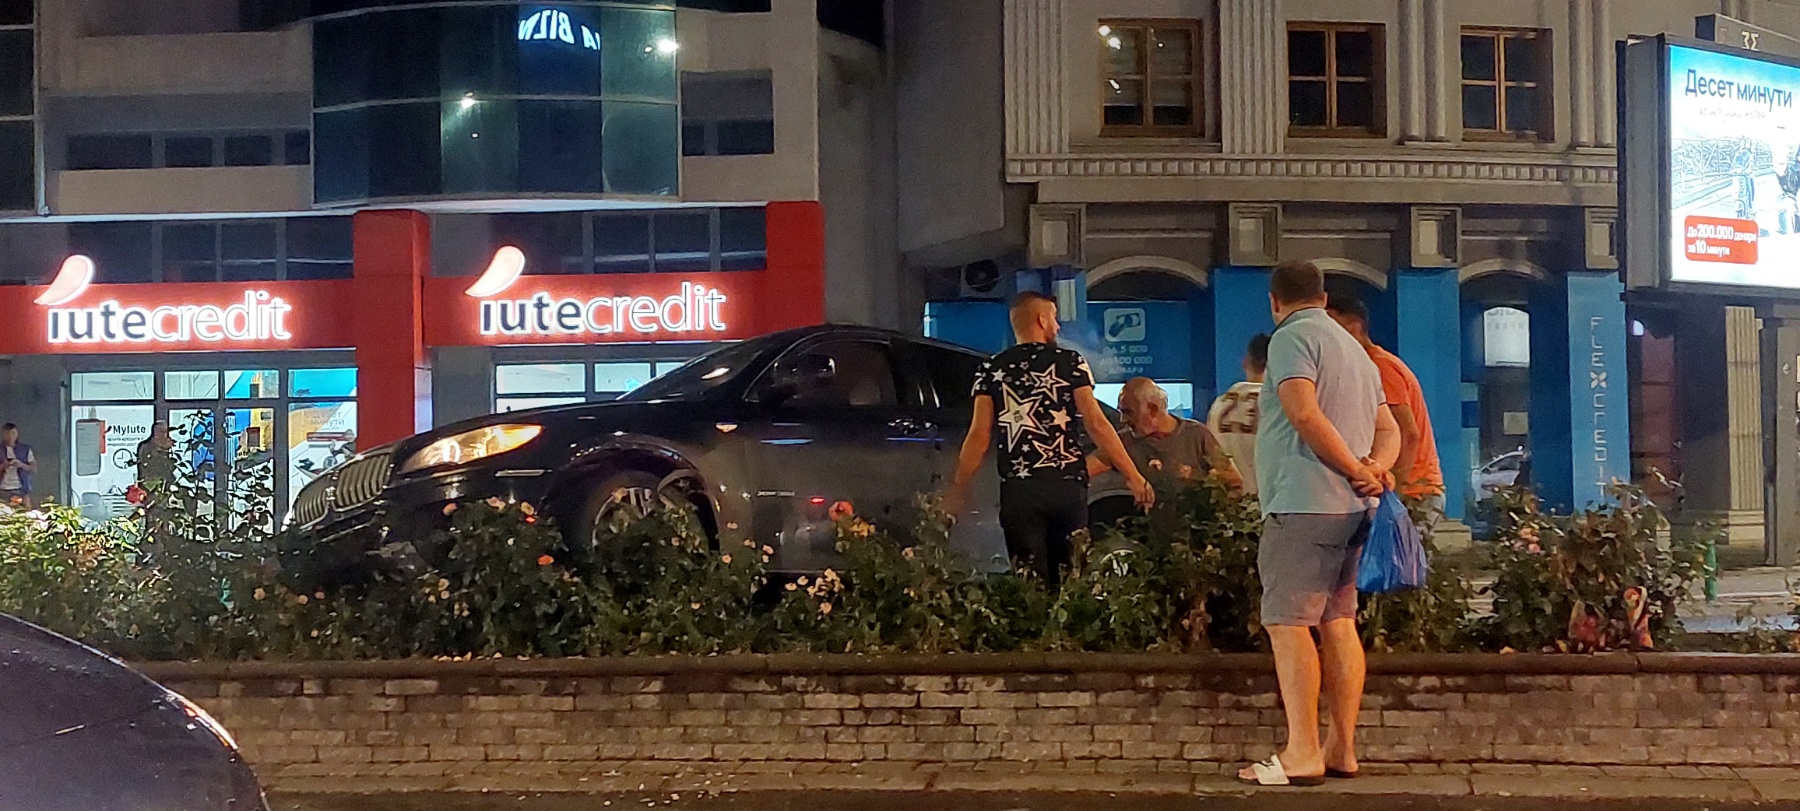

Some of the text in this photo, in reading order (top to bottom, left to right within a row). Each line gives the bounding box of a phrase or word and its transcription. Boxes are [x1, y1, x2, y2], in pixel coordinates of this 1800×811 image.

[1685, 68, 1734, 99] Десет
[1737, 82, 1792, 113] минути
[1696, 239, 1707, 254] 10
[1697, 223, 1734, 240] 200.000
[49, 290, 292, 342] iutecredit
[481, 283, 726, 334] iutecredit
